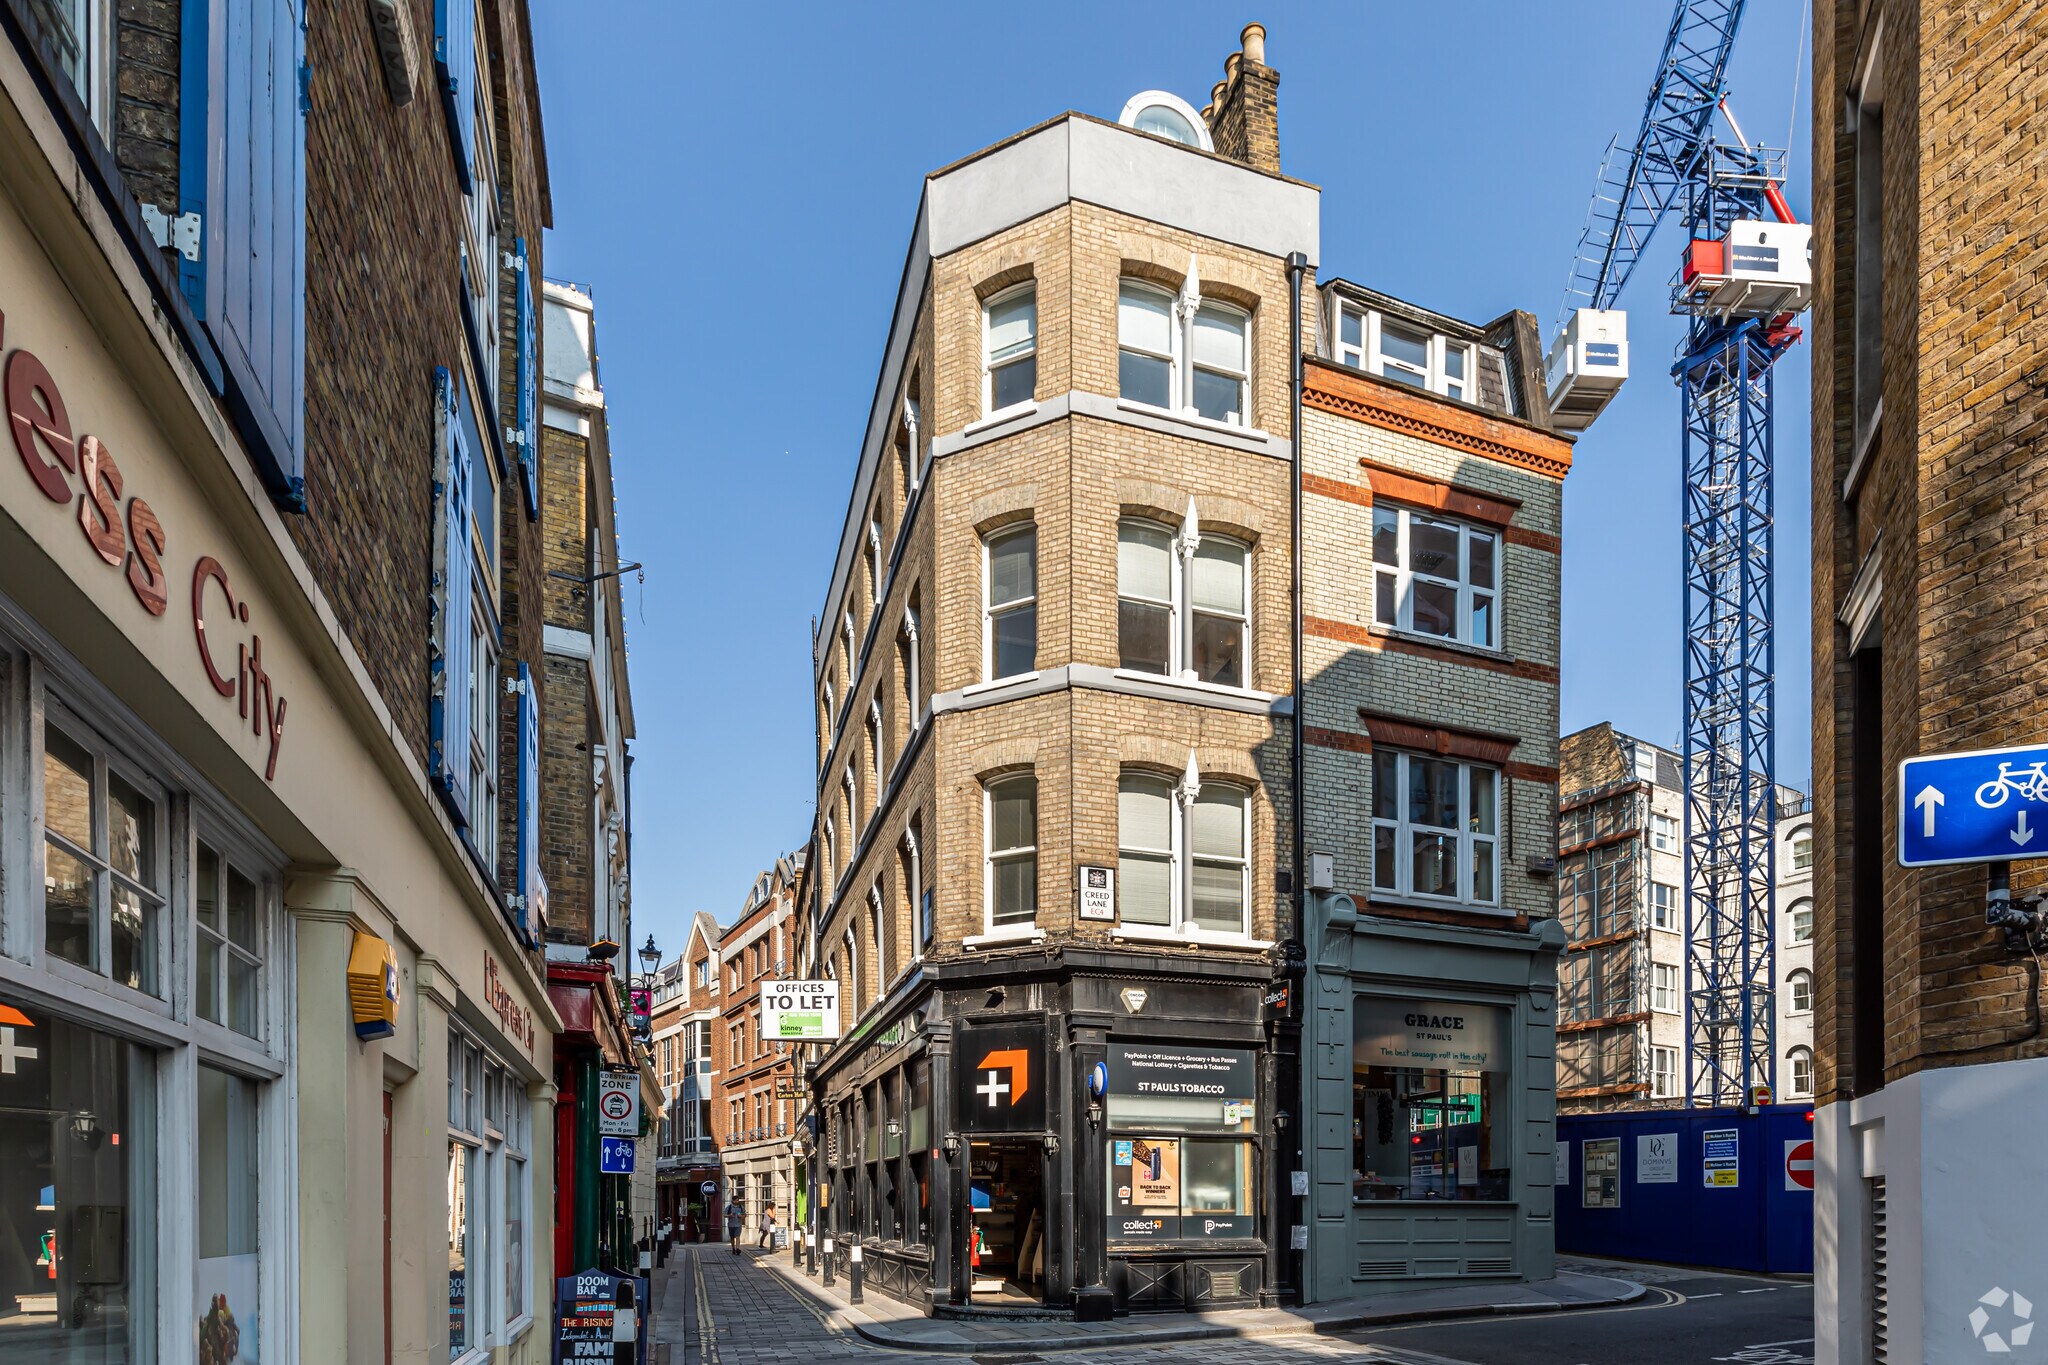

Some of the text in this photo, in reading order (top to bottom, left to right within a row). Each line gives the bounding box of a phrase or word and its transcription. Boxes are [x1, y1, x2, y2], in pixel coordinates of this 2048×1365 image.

[0, 310, 287, 781] ess City
[1085, 891, 1110, 899] CREED
[1090, 907, 1104, 915] EC4
[776, 984, 824, 993] OFFICES
[766, 996, 835, 1009] TO LET
[1405, 1014, 1464, 1030] GRACE
[1381, 1048, 1393, 1056] The
[1395, 1048, 1409, 1056] best
[1411, 1051, 1438, 1061] sausage
[1460, 1052, 1471, 1060] the
[1472, 1053, 1487, 1064] city!
[1155, 1061, 1172, 1069] Lottery
[602, 1080, 631, 1089] ZONE
[1138, 1082, 1224, 1093] ST PAULS TOBACCO
[577, 1277, 609, 1286] DOOM
[577, 1286, 597, 1295] BAR
[562, 1318, 613, 1327] THE RISING
[575, 1342, 615, 1355] FAMI
